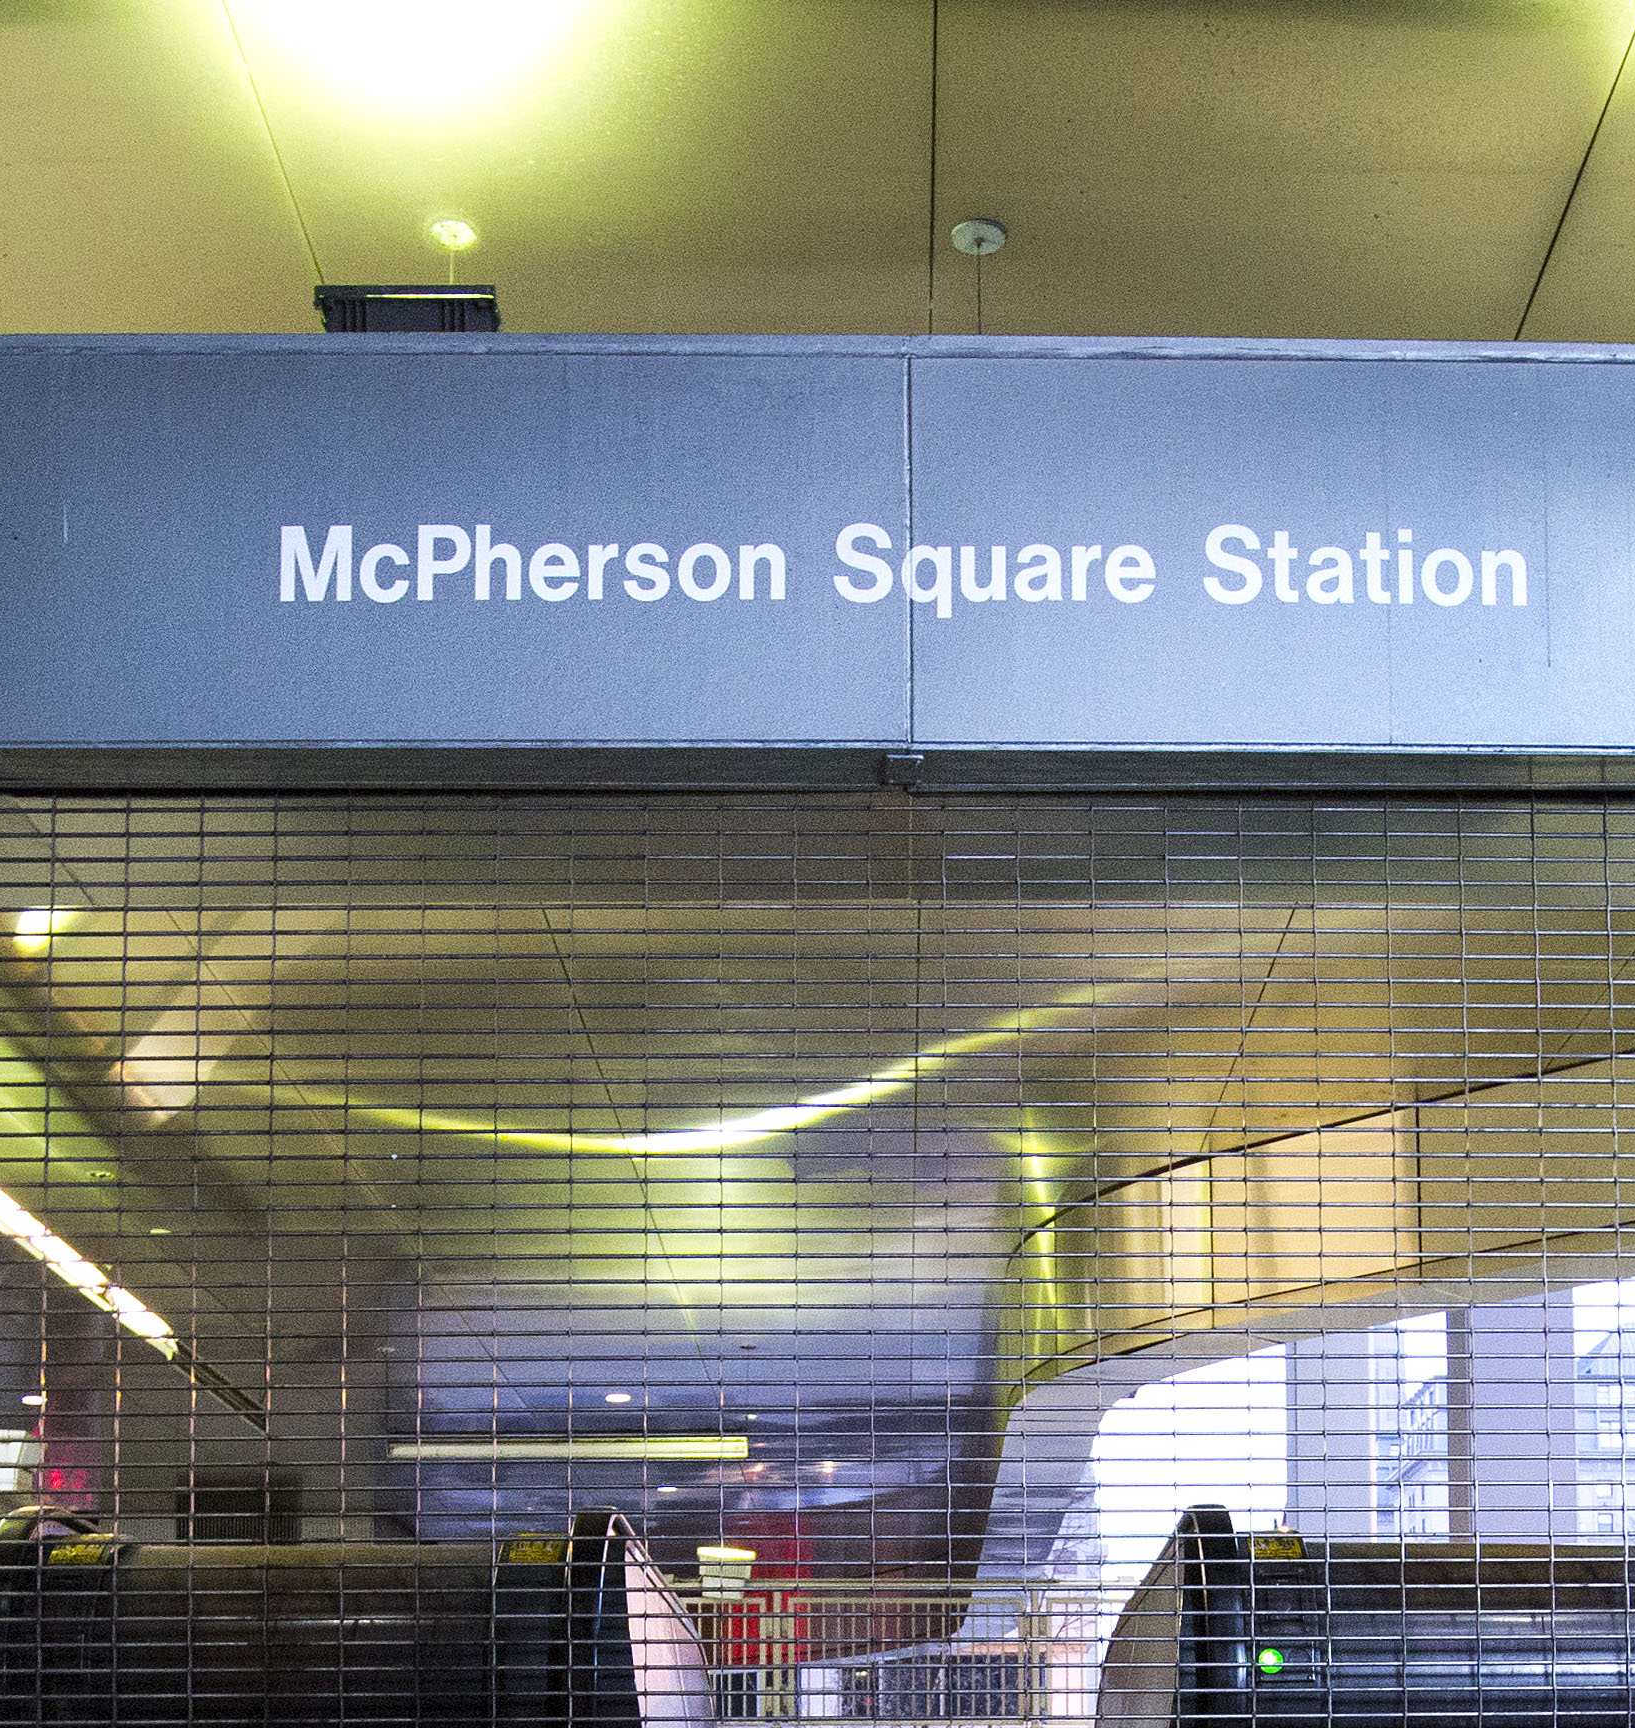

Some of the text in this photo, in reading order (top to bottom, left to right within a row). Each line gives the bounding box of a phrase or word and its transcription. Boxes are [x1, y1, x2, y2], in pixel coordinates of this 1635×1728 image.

[279, 521, 1532, 620] McPherson Square Station
